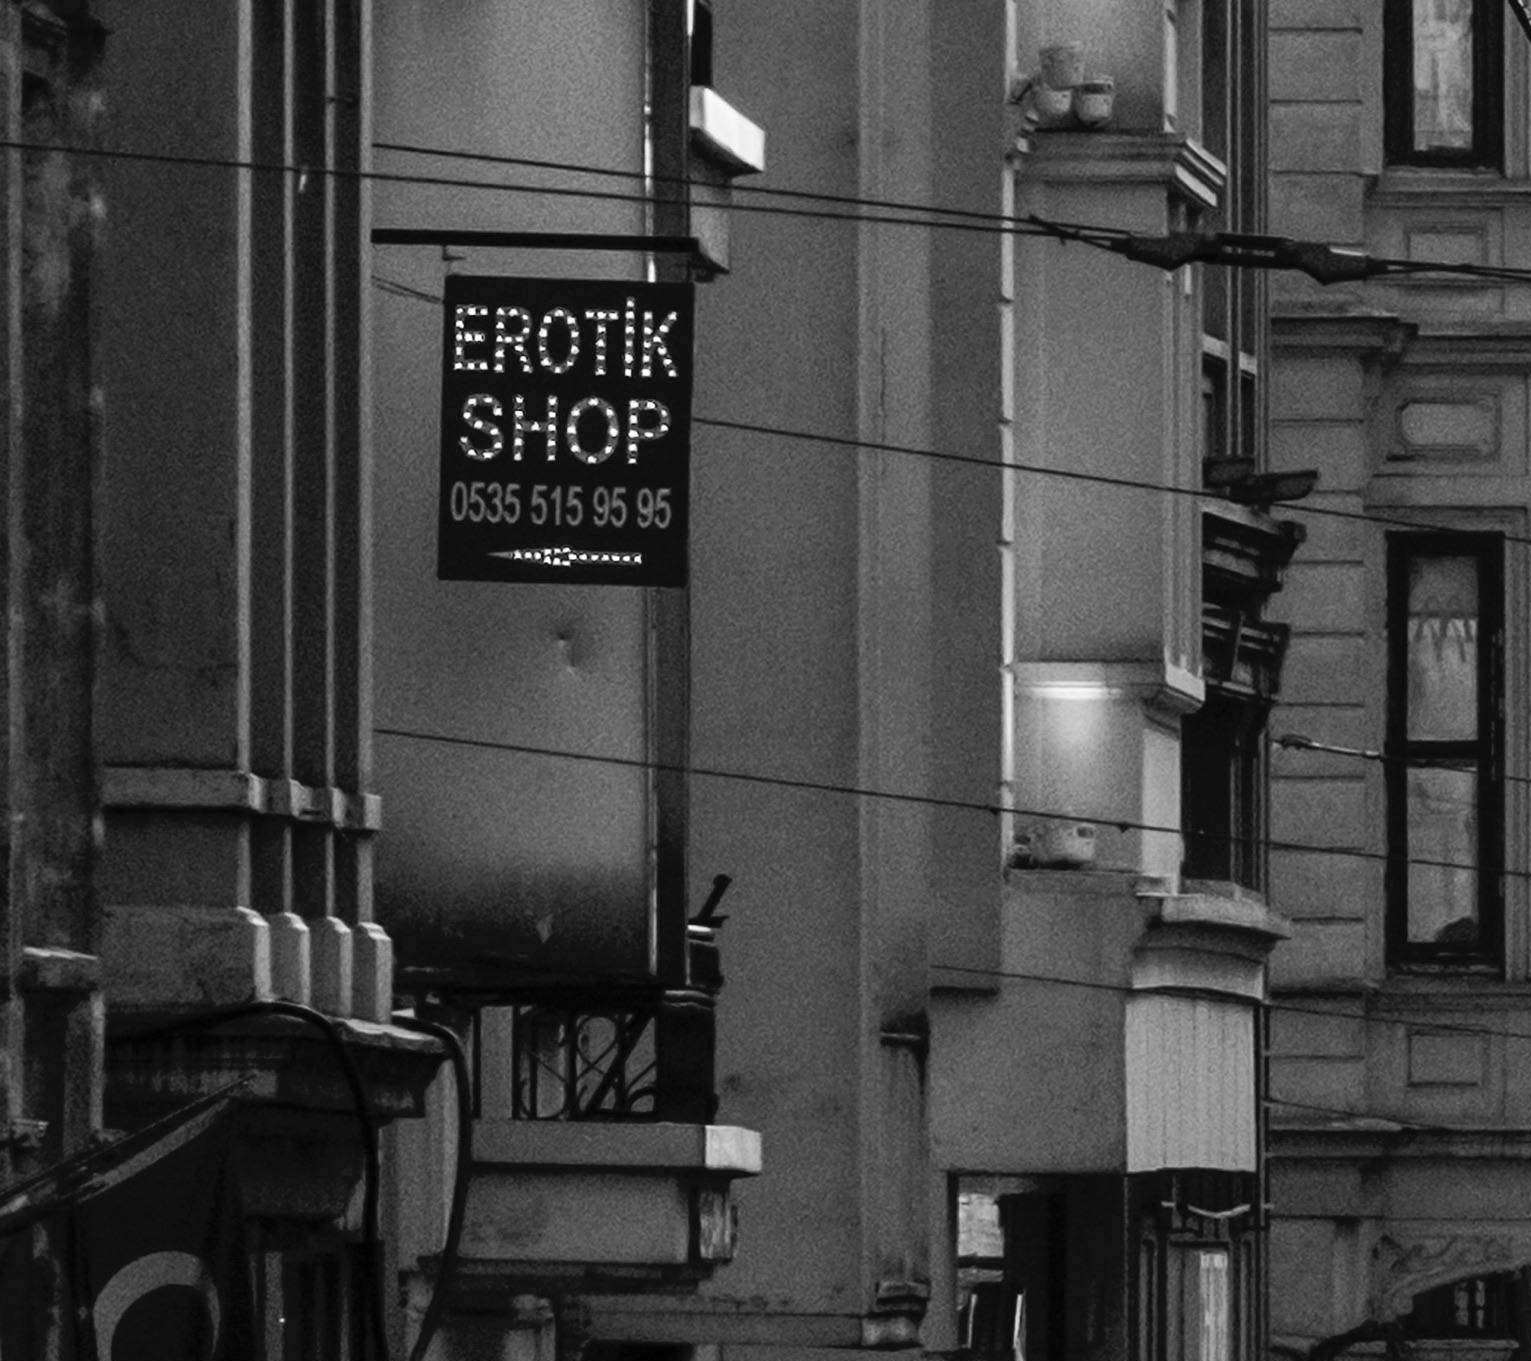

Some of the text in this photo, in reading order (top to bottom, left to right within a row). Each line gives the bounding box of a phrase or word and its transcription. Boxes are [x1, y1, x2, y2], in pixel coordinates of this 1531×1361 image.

[457, 392, 673, 465] SHOP
[450, 481, 672, 529] 0535 515 95 95
